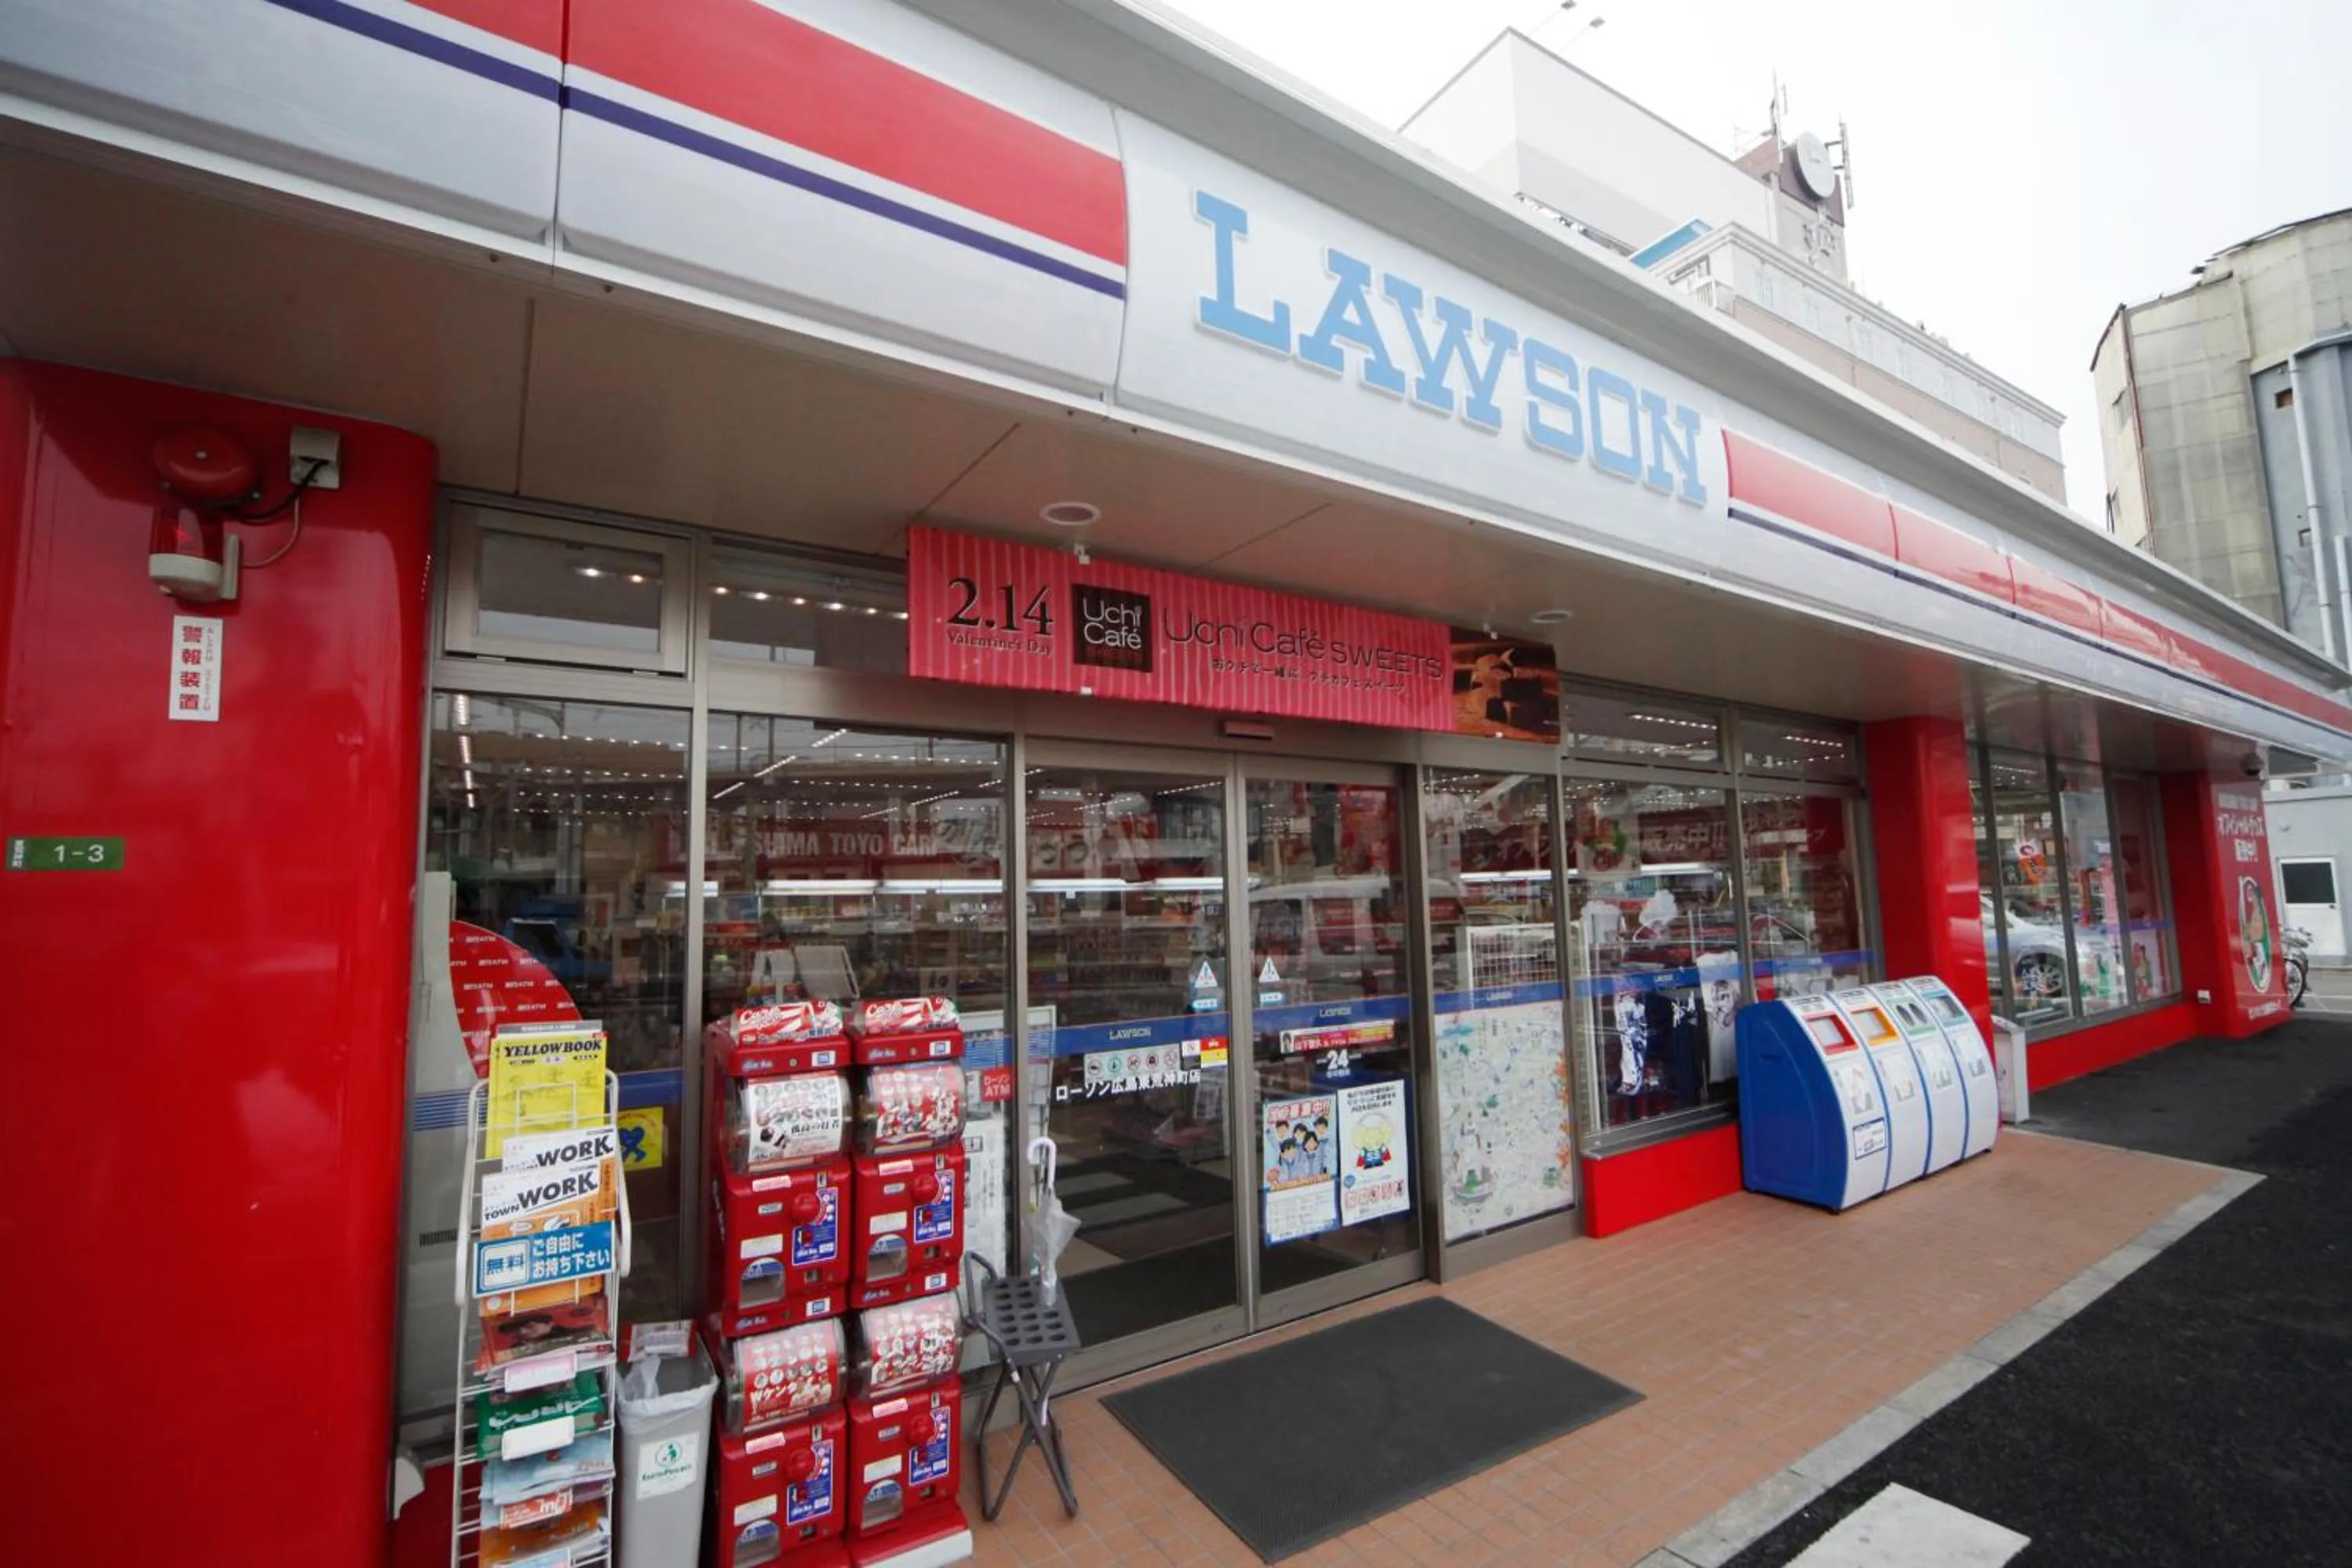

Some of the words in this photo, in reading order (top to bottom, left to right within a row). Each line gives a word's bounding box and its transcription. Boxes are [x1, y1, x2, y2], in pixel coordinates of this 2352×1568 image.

[1195, 190, 1708, 506] LAWSON
[946, 578, 1054, 637] 2.14
[1082, 597, 1142, 626] Uchi
[1027, 638, 1054, 659] Day
[1083, 622, 1142, 650] Café
[1163, 608, 1245, 647] Uchi
[1251, 622, 1325, 660] Café
[1330, 641, 1443, 678] SWEETS
[54, 844, 104, 863] 1-3
[829, 833, 884, 855] TOYO
[1109, 1026, 1152, 1040] LAWSON
[1327, 1049, 1349, 1070] 24
[536, 1135, 614, 1167] WORK
[485, 1203, 520, 1221] TOWN
[517, 1171, 598, 1208] WORK
[533, 1232, 585, 1256] ご自由に
[485, 1252, 524, 1276] 無料
[532, 1250, 611, 1279] お持ち下さい
